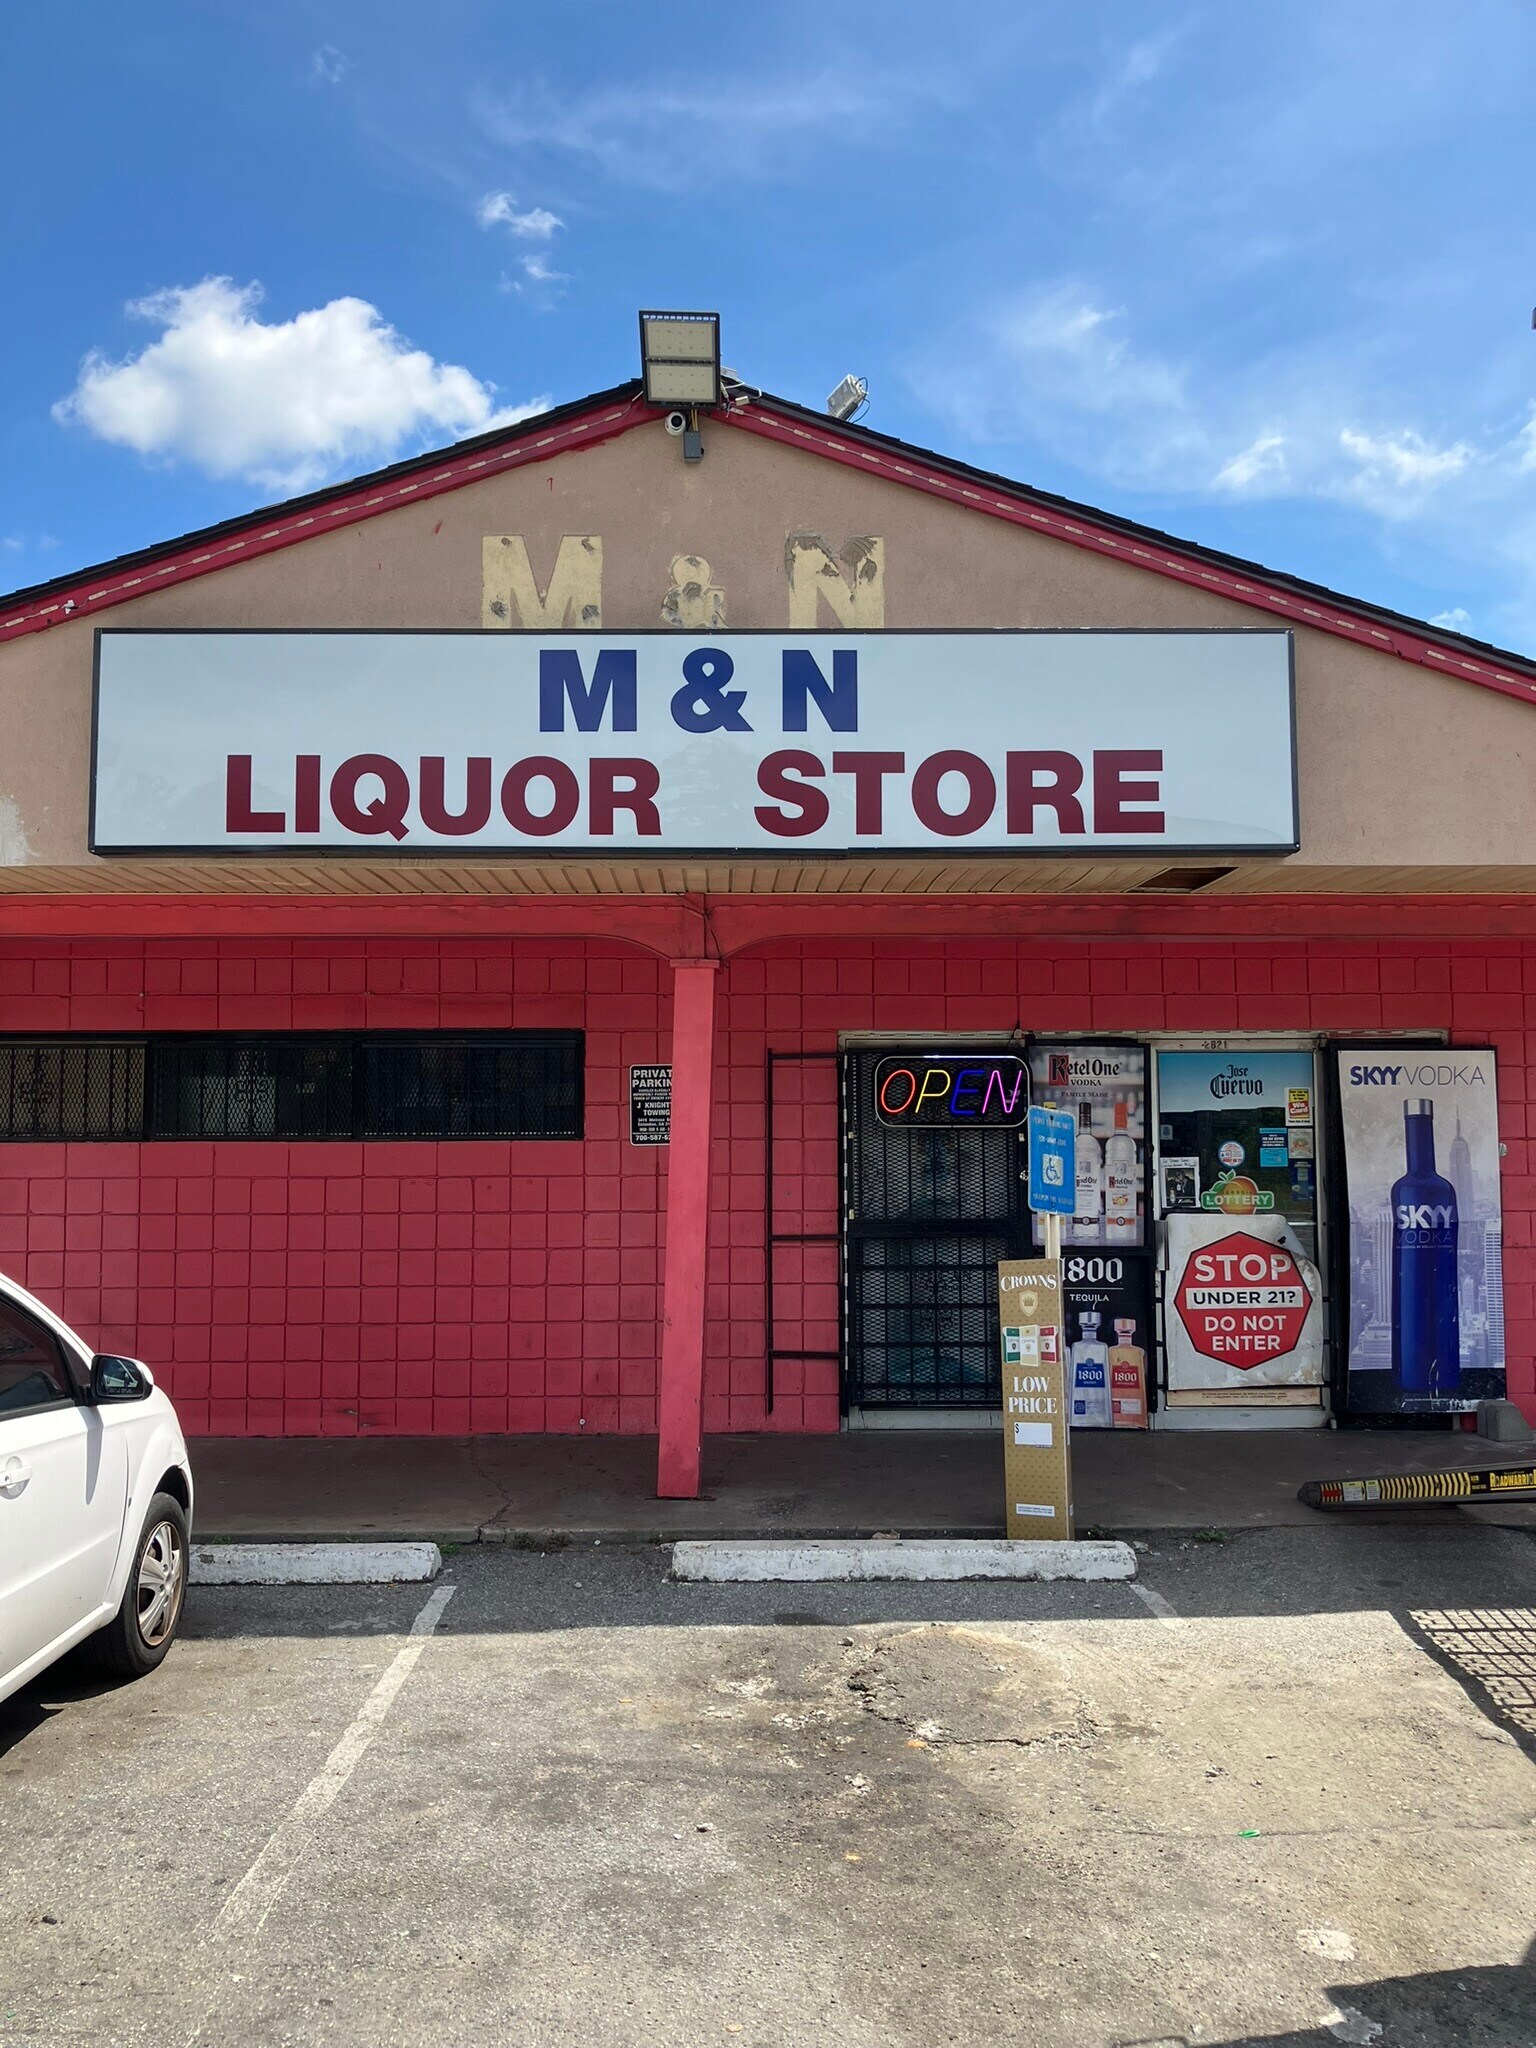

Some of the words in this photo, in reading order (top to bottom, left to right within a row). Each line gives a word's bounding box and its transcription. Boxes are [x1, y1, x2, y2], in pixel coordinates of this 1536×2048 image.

[482, 535, 602, 628] M
[785, 531, 884, 628] N
[539, 649, 637, 732] M
[671, 647, 754, 733] &
[782, 649, 858, 732] N
[226, 753, 662, 842] LIQUOR
[754, 749, 1165, 837] STORE
[633, 1069, 672, 1078] PRIVAT
[1050, 1056, 1090, 1083] Ketel
[1092, 1058, 1120, 1076] One
[1227, 1064, 1249, 1078] Jose
[1350, 1065, 1402, 1086] SKYY
[1403, 1065, 1486, 1086] VODKA
[632, 1079, 672, 1088] PARKIN
[880, 1068, 1023, 1115] OPEN
[1210, 1073, 1263, 1099] Cuervo
[1206, 1194, 1270, 1205] LOTTERY
[1396, 1204, 1453, 1229] SKYY
[1397, 1230, 1453, 1244] VODKA
[1194, 1253, 1292, 1282] STOP
[1000, 1273, 1057, 1292] CROWNS
[1069, 1293, 1110, 1302] TEQUILA
[1193, 1291, 1261, 1305] UNDER
[1267, 1290, 1297, 1304] 21?
[1204, 1315, 1236, 1332] DO
[1243, 1315, 1287, 1331] NOT
[1212, 1335, 1281, 1351] ENTER
[1078, 1370, 1102, 1380] 1800
[1114, 1372, 1137, 1382] 1800
[1013, 1376, 1051, 1393] LOW
[1008, 1397, 1058, 1414] PRICE
